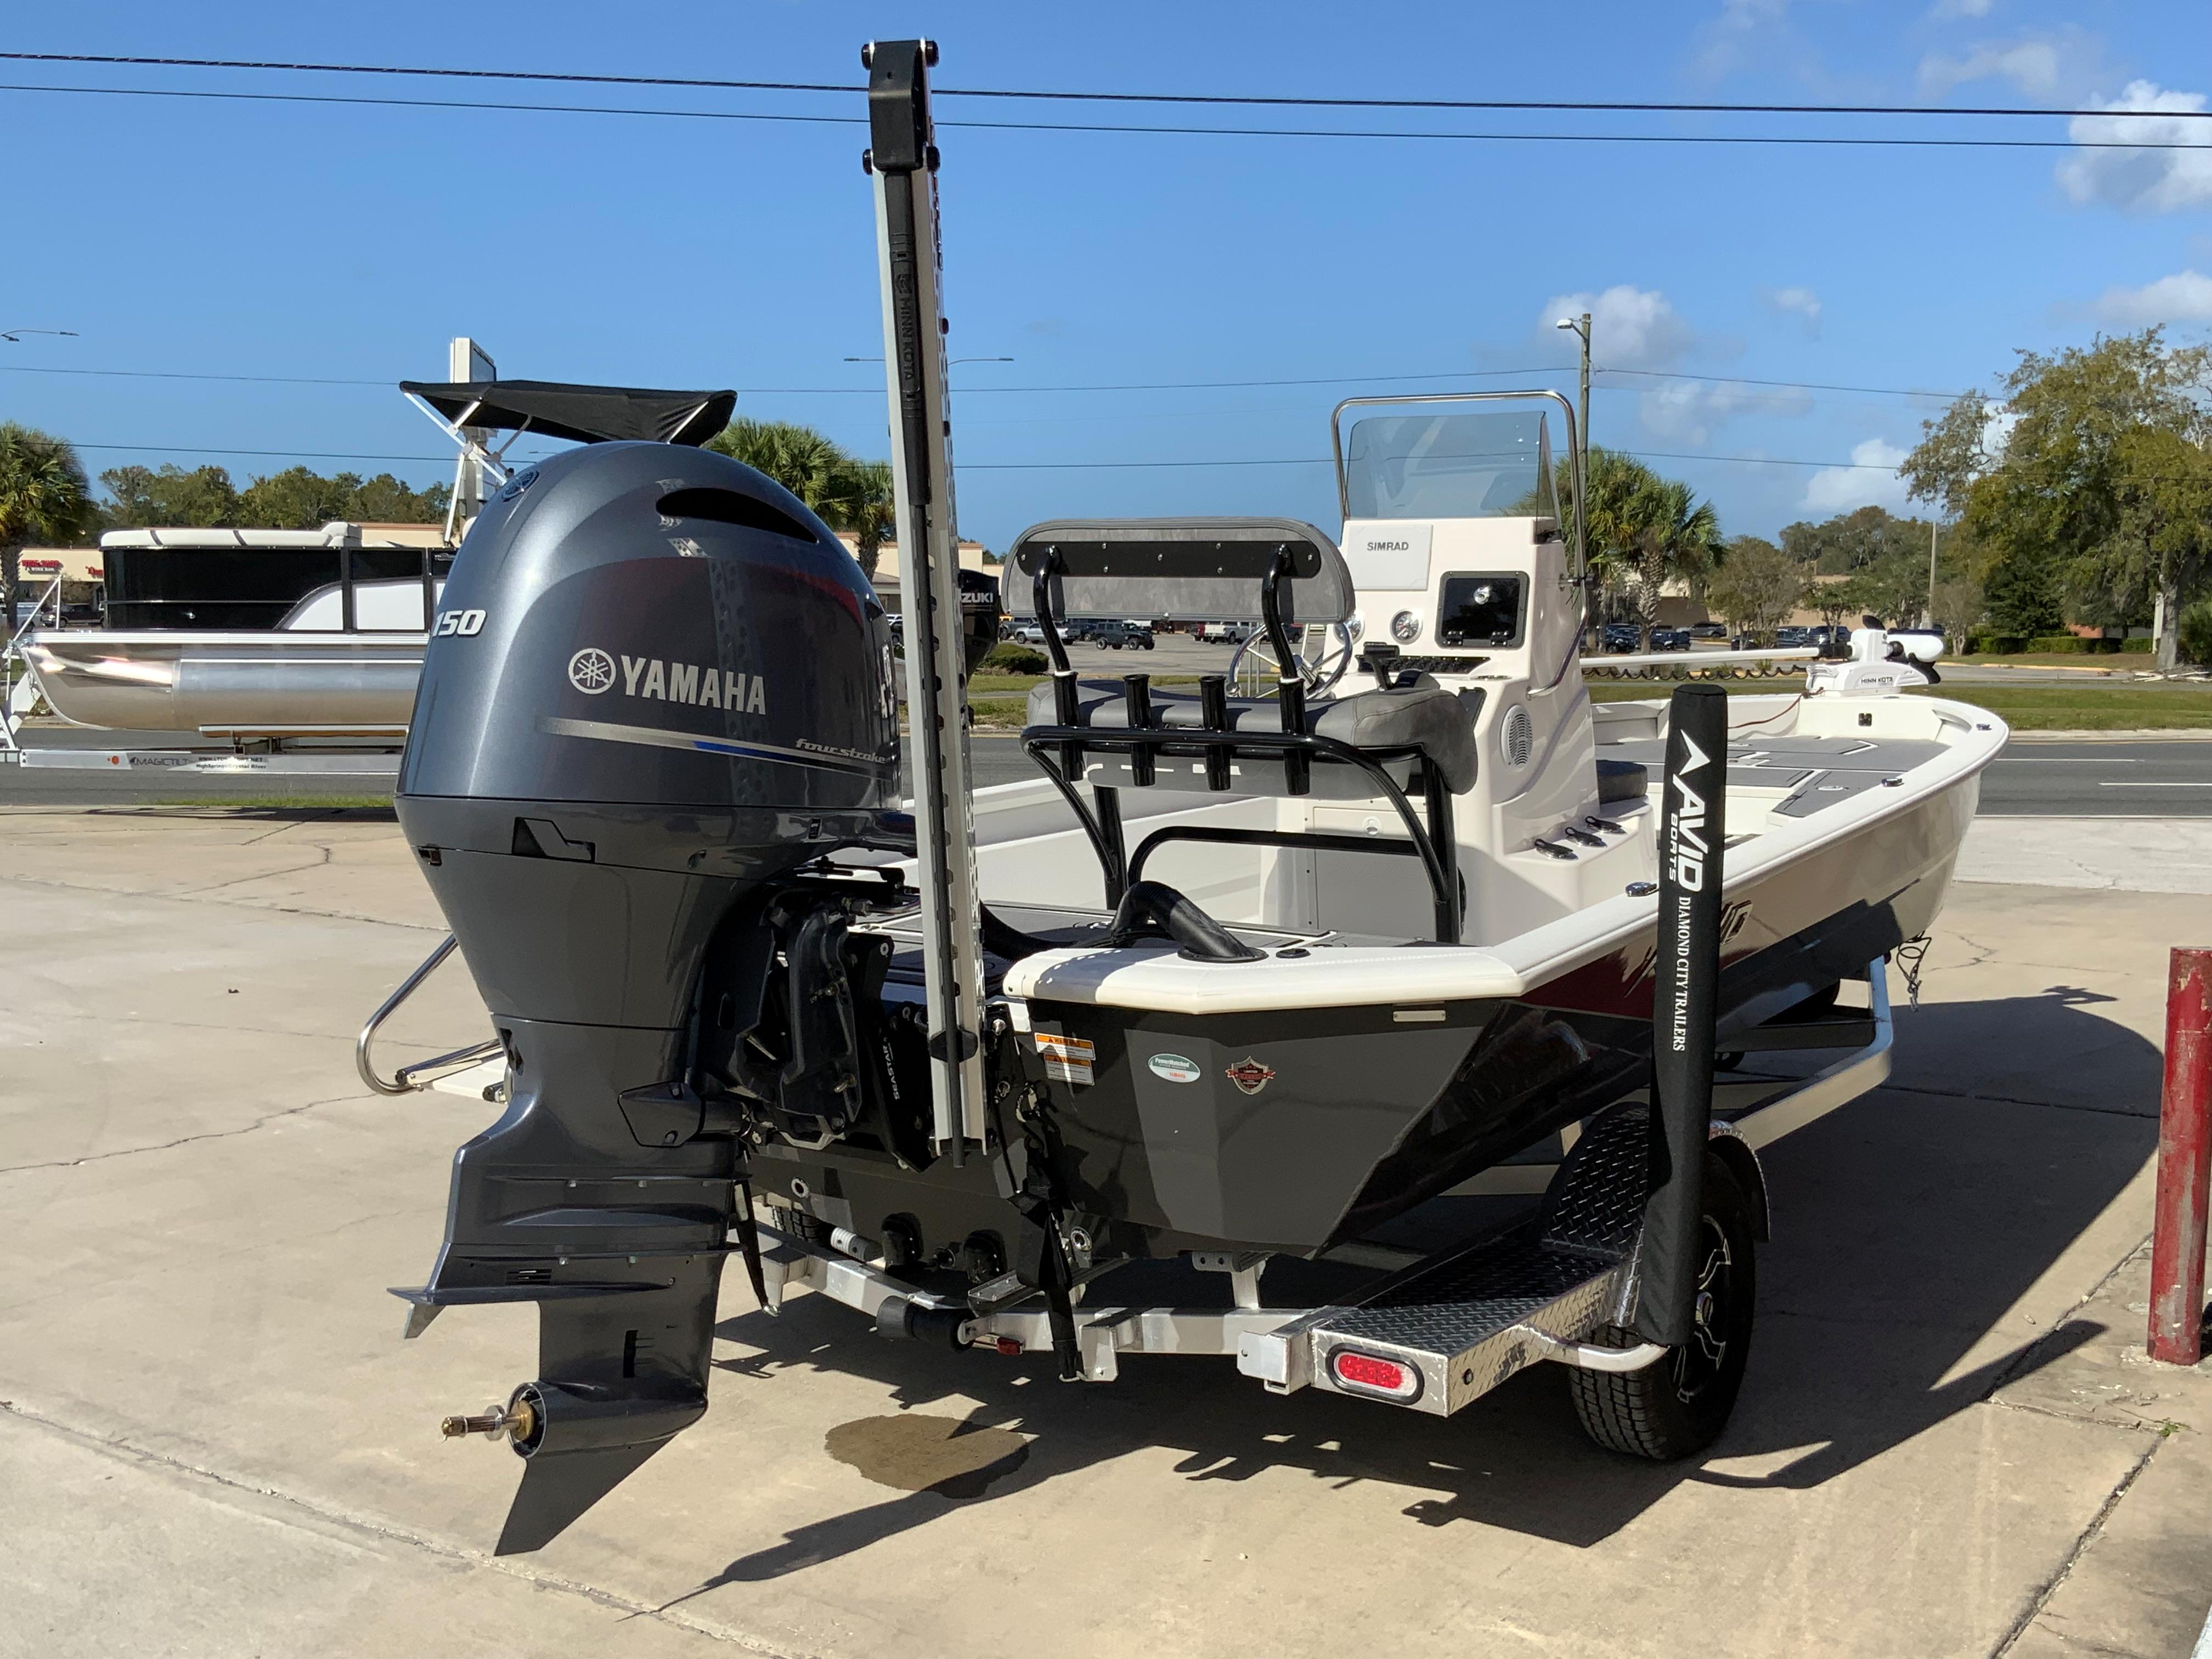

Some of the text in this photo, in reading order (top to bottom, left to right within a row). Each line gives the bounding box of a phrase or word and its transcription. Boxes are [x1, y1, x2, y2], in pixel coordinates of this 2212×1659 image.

[900, 297, 916, 381] MINN KOTA
[1367, 542, 1409, 551] SIMRAD
[432, 609, 487, 637] 150
[962, 592, 994, 603] ZUKI
[620, 654, 766, 715] YAMAHA
[136, 758, 188, 766] MAGICTILT
[1669, 812, 1678, 882] BOATS
[1673, 774, 1708, 892] AVID
[1673, 896, 1691, 1052] DIAMOND CITY TRAILERS
[882, 1045, 900, 1100] SEASTAR
